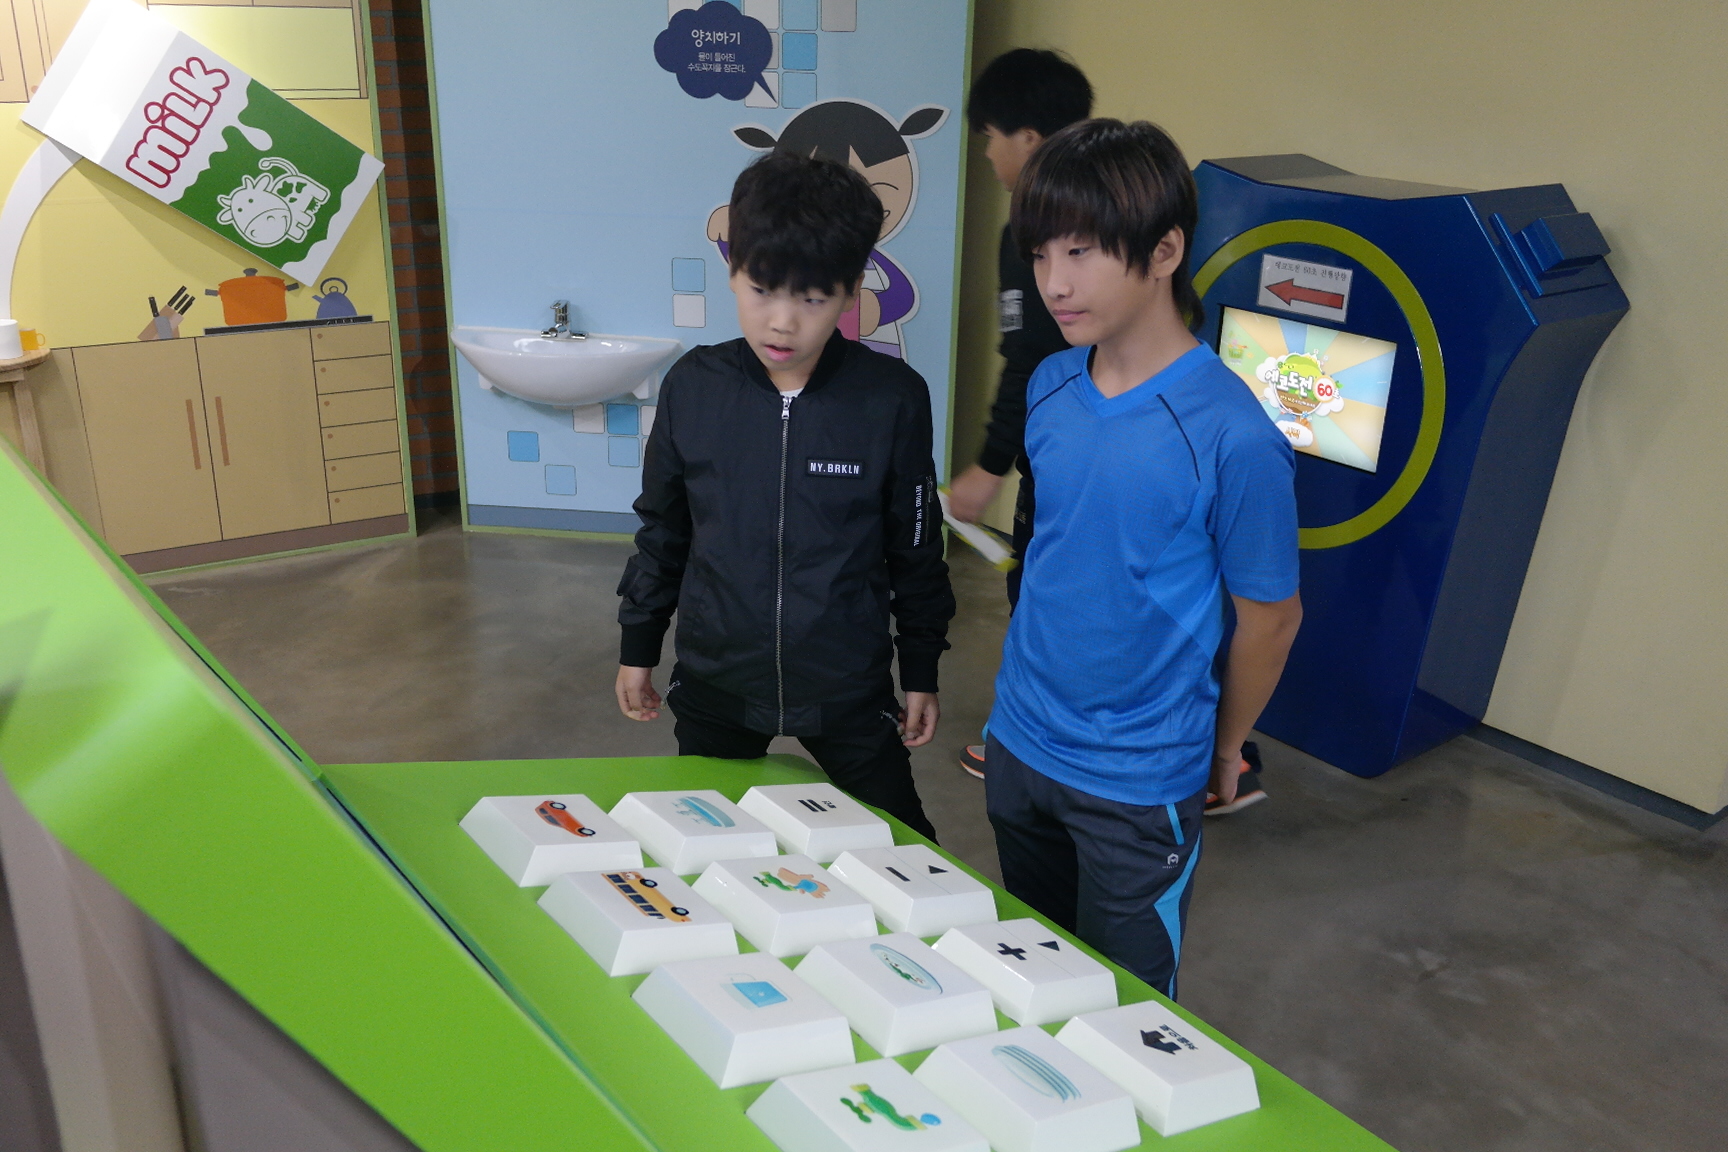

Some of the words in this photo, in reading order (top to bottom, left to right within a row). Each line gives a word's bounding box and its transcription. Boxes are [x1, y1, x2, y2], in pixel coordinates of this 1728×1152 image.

[691, 29, 741, 48] 양치하기
[687, 62, 722, 73] 수도꼭지를
[1265, 368, 1314, 398] 에코도전
[809, 461, 860, 475] NY.BRKLN
